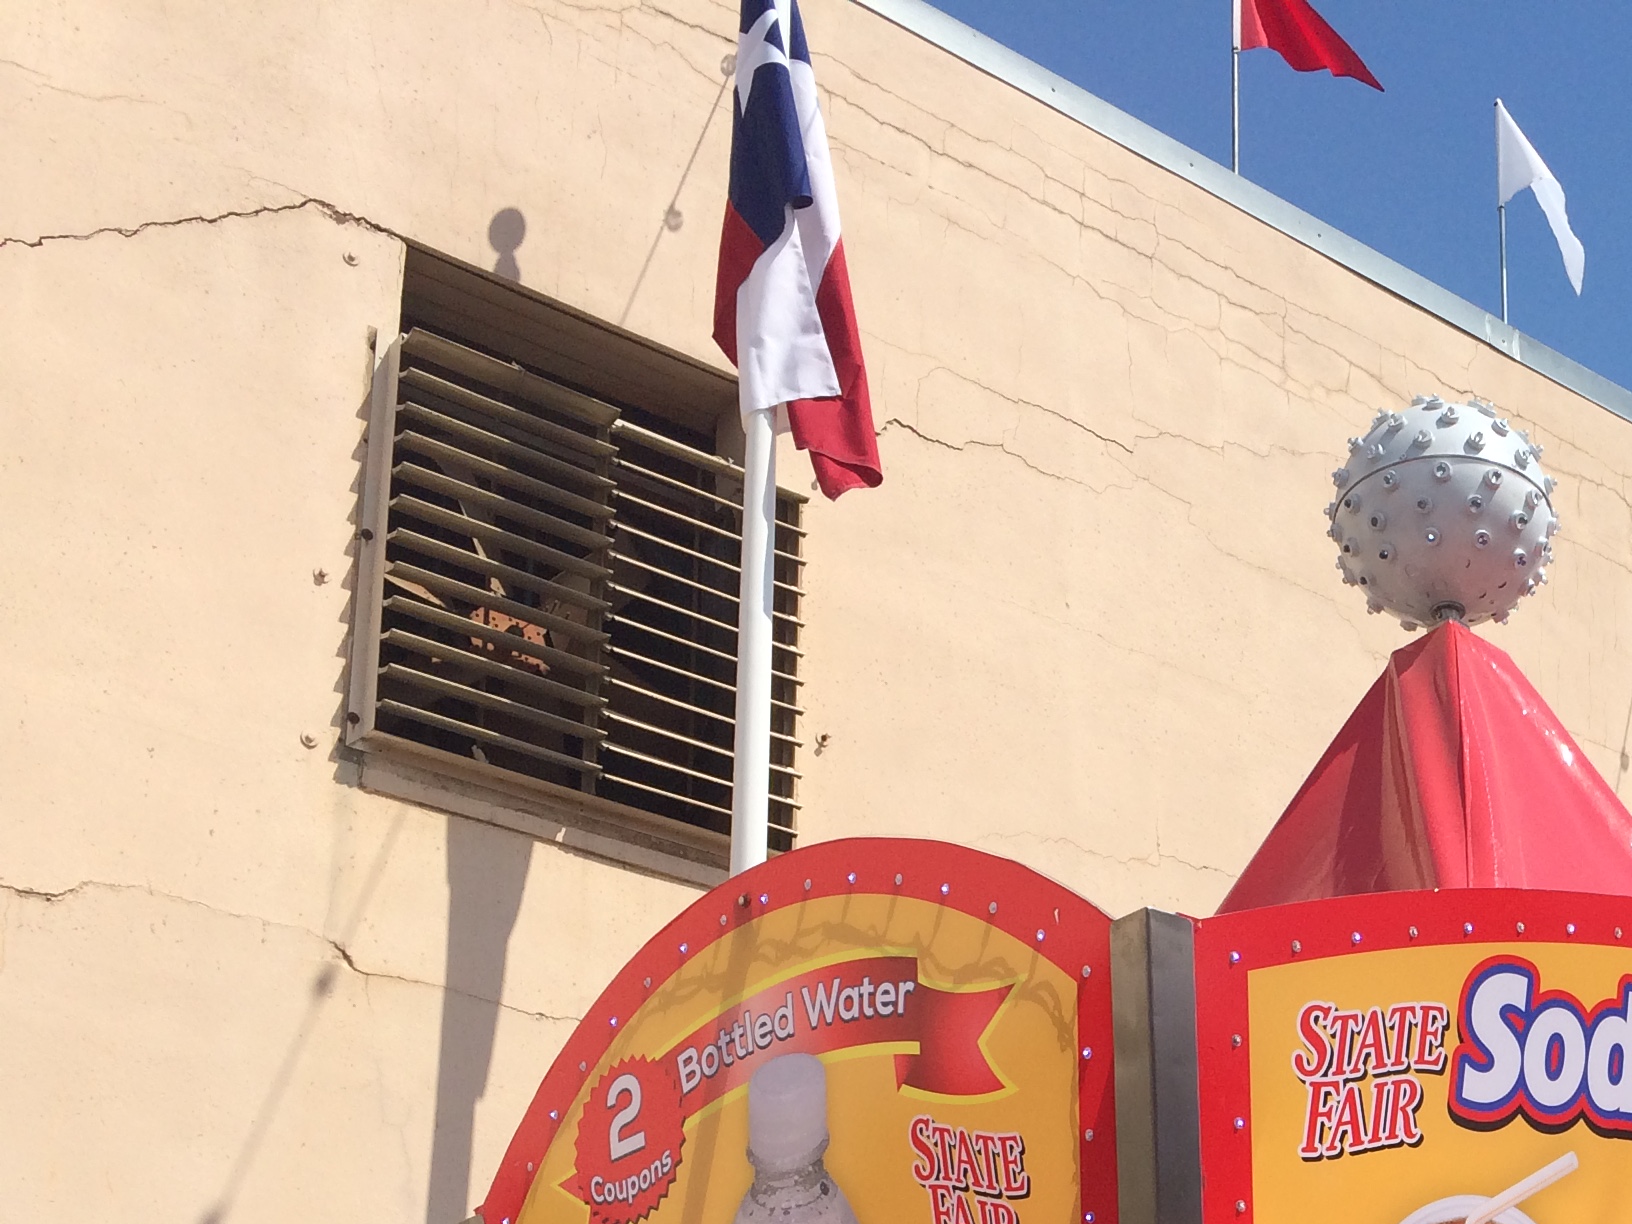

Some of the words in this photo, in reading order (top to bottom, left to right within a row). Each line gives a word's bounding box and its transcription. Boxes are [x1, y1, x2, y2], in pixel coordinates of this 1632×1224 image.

[675, 999, 796, 1096] Bottled
[801, 976, 916, 1029] Water
[1292, 999, 1448, 1080] STATE
[605, 1072, 646, 1161] 2
[909, 1115, 1027, 1197] STATE
[1297, 1077, 1423, 1159] FAIR
[590, 1146, 673, 1206] Coupons
